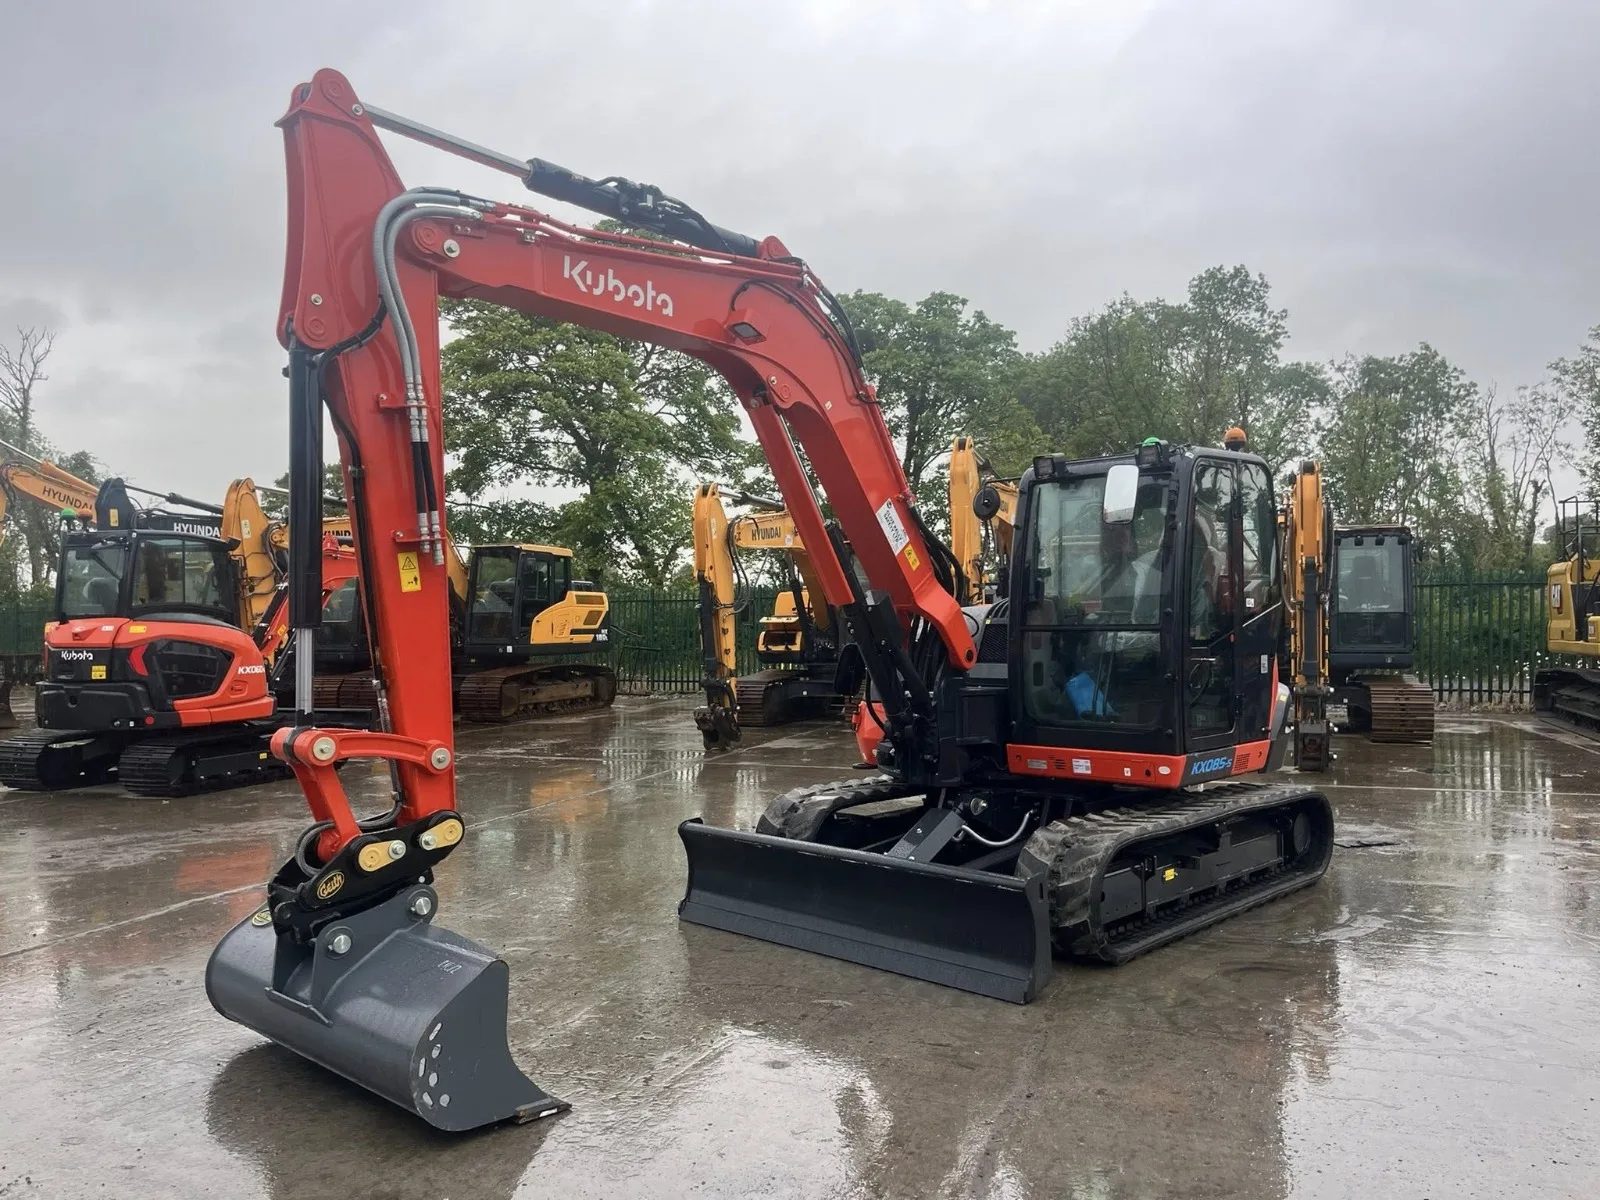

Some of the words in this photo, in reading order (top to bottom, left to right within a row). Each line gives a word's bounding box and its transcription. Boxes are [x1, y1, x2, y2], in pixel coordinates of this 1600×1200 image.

[563, 255, 673, 317] Kubota
[173, 522, 221, 537] HYUNDA
[751, 526, 781, 541] HYUNDAI
[61, 650, 94, 660] Kubota
